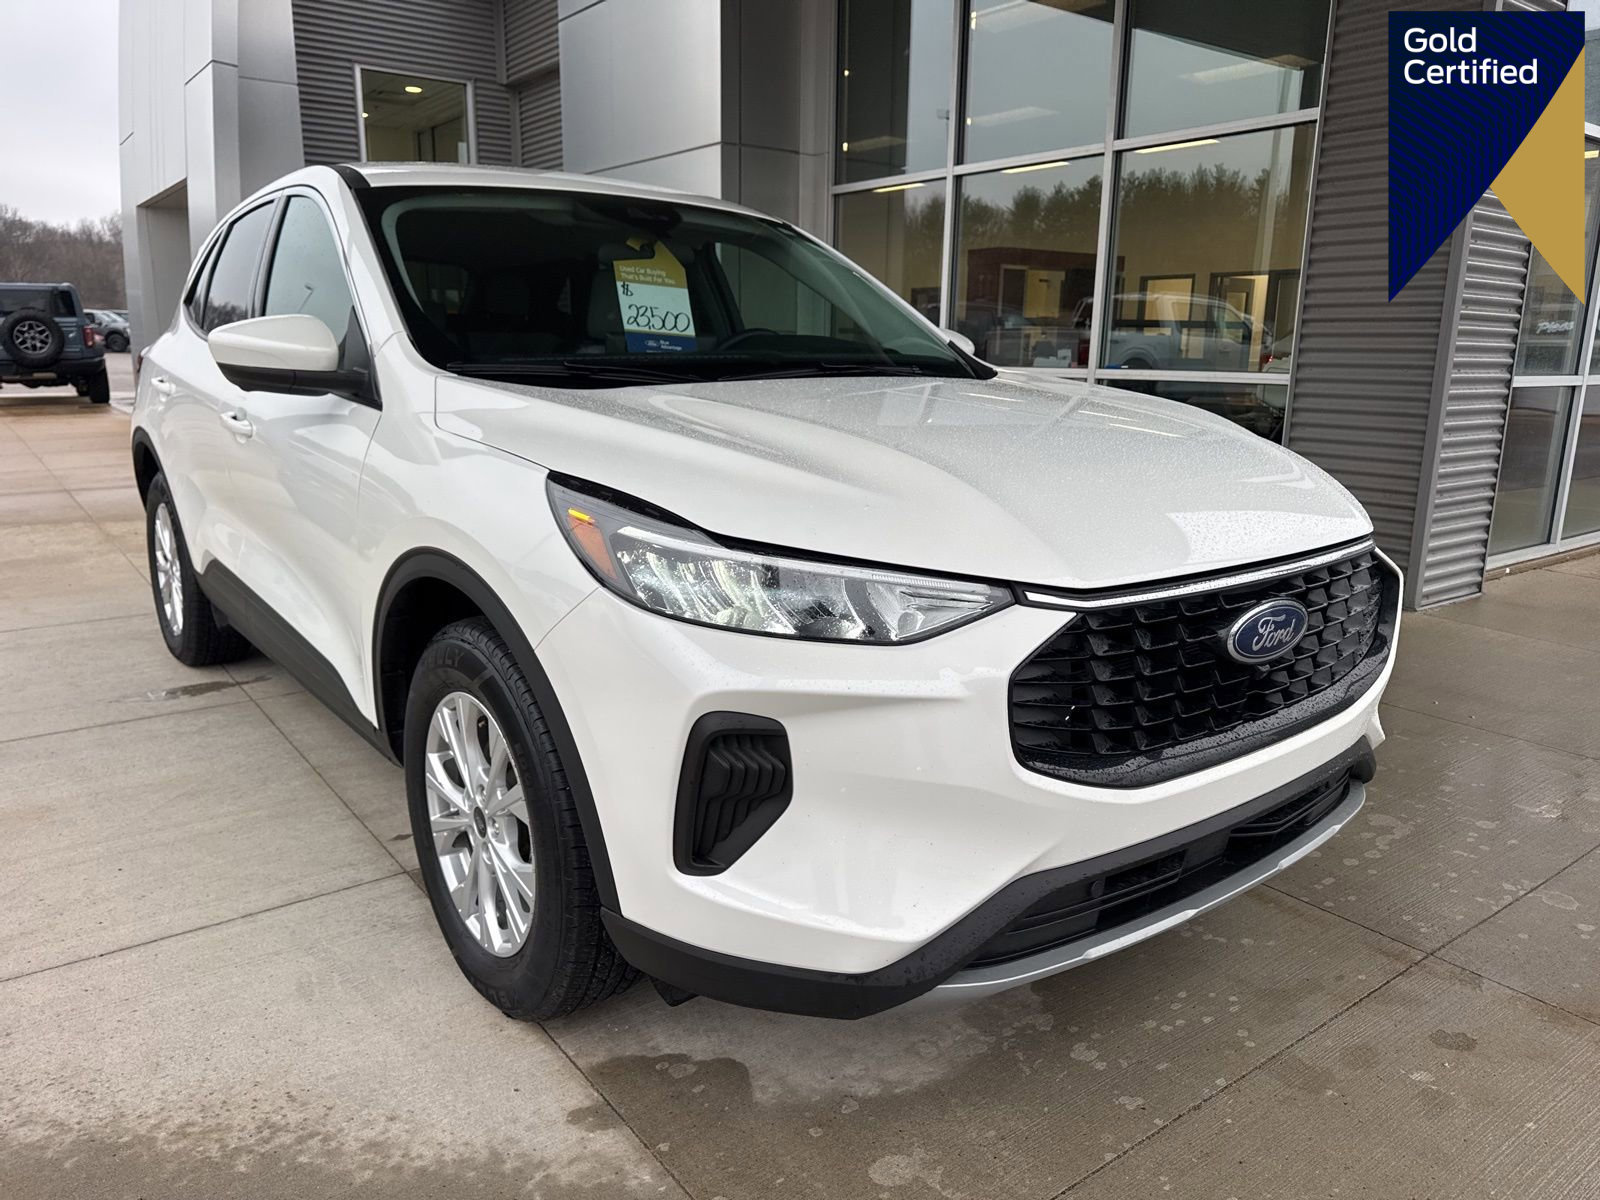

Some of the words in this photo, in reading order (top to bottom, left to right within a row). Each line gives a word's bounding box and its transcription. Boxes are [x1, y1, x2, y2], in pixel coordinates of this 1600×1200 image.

[620, 265, 635, 273] Used
[647, 268, 666, 277] Buying
[626, 303, 690, 332] 23,500
[1252, 614, 1296, 652] Ford
